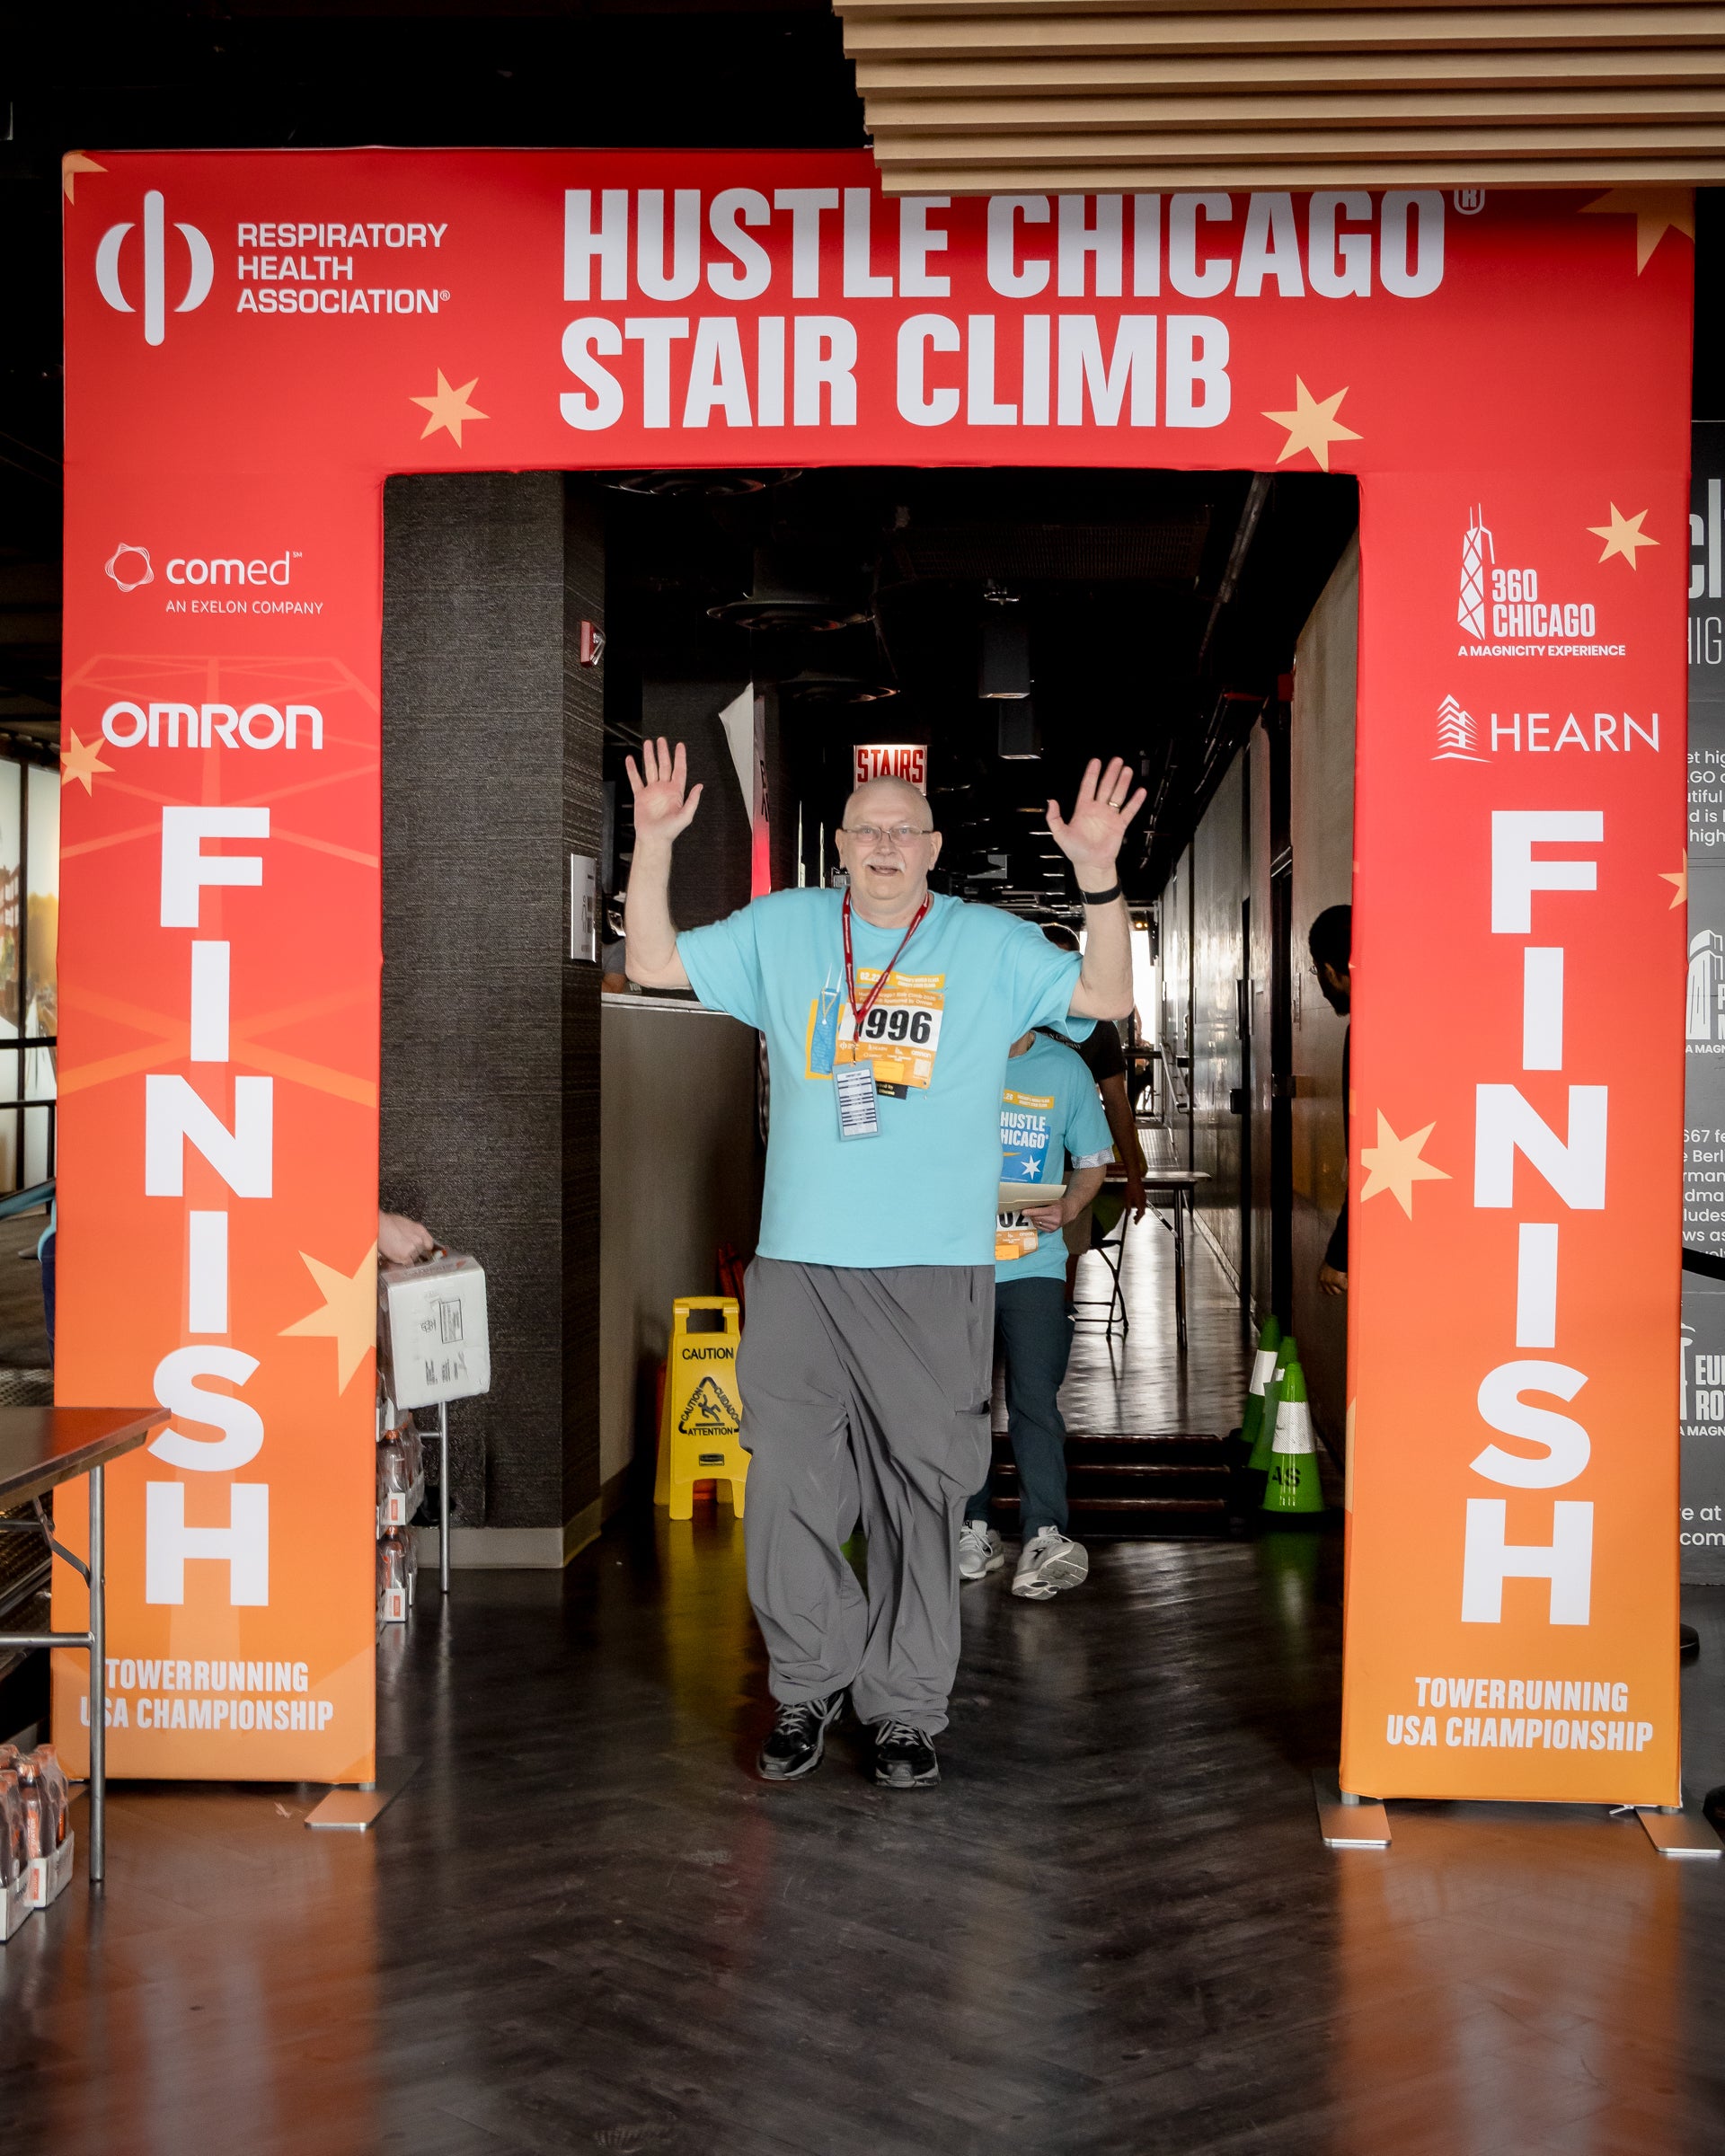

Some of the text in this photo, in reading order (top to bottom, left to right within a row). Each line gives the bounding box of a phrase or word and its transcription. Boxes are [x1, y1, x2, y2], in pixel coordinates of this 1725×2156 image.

[237, 223, 448, 248] RESPIRATORY
[563, 187, 951, 301] HUSTLE
[238, 255, 353, 280] HEALTH
[559, 313, 1232, 431] STAIR CLIMB
[166, 550, 290, 586] comed
[1491, 569, 1538, 603] 360
[166, 599, 324, 614] AN EXELON COMPANY
[1492, 604, 1596, 638] CHICAGO
[1457, 644, 1626, 657] A MAGNICITY EXPERIENCE
[1491, 711, 1660, 753] HEARN
[857, 749, 924, 782] STAIRS
[1705, 808, 1718, 823] is
[1000, 1111, 1046, 1132] HUSTLE
[1000, 1128, 1045, 1149] HICAGO
[1693, 1149, 1725, 1162] Berl
[146, 807, 273, 1606] FINISH
[1461, 810, 1608, 1625] FINISH
[682, 1348, 734, 1360] CAUTION
[680, 1387, 703, 1422] CAUTION
[714, 1387, 739, 1421] CUIDADO
[687, 1427, 733, 1436] ATTENTION
[1700, 1506, 1721, 1521] at
[105, 1658, 309, 1692] TOWERRUNNING
[1415, 1676, 1629, 1713] TOWERRUNNING
[137, 1698, 334, 1731] CHAMPIONSHIP
[1386, 1714, 1654, 1752] USA CHAMPIONSHIP
